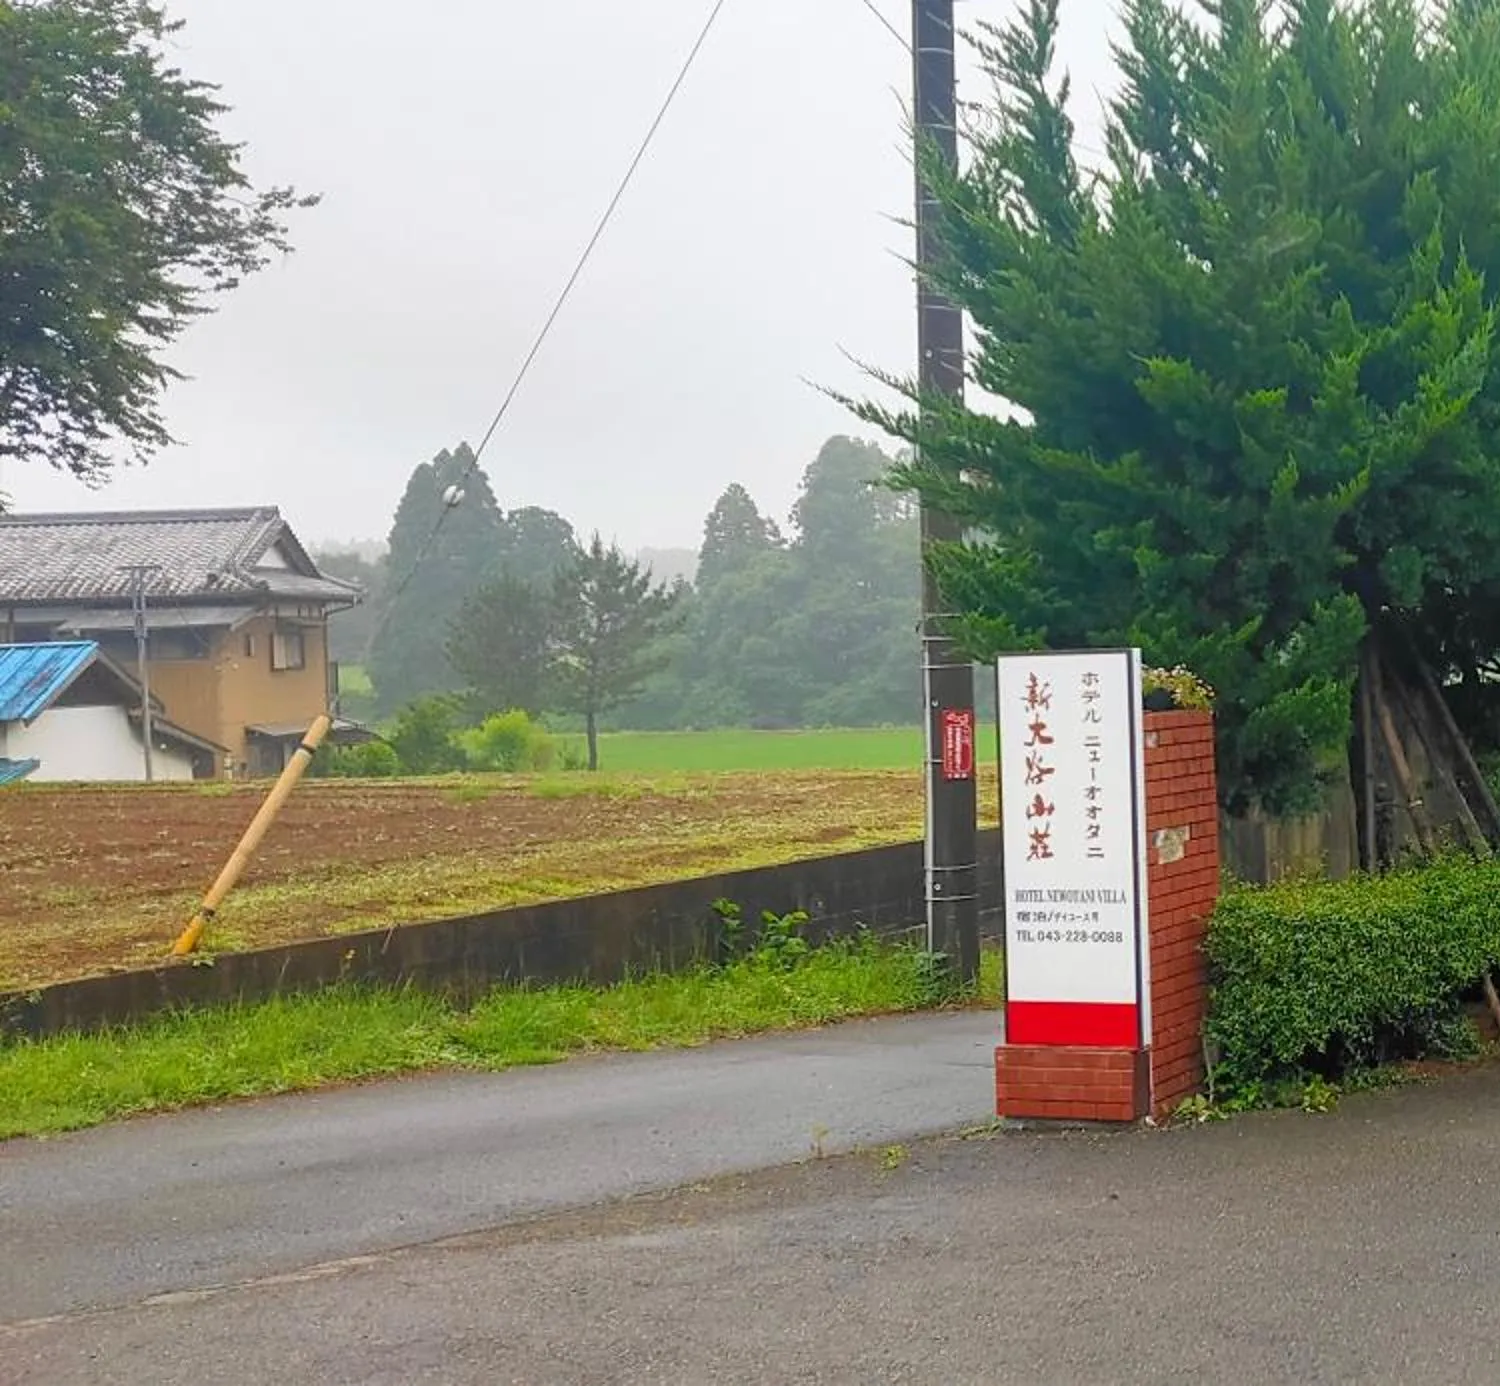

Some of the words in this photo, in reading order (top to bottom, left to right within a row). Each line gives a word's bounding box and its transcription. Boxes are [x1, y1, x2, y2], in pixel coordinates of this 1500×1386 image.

[1081, 671, 1102, 723] ホテル
[1083, 734, 1105, 859] ニューオオタニ
[1015, 889, 1043, 902] HOTEL
[1097, 889, 1127, 904] VILLA
